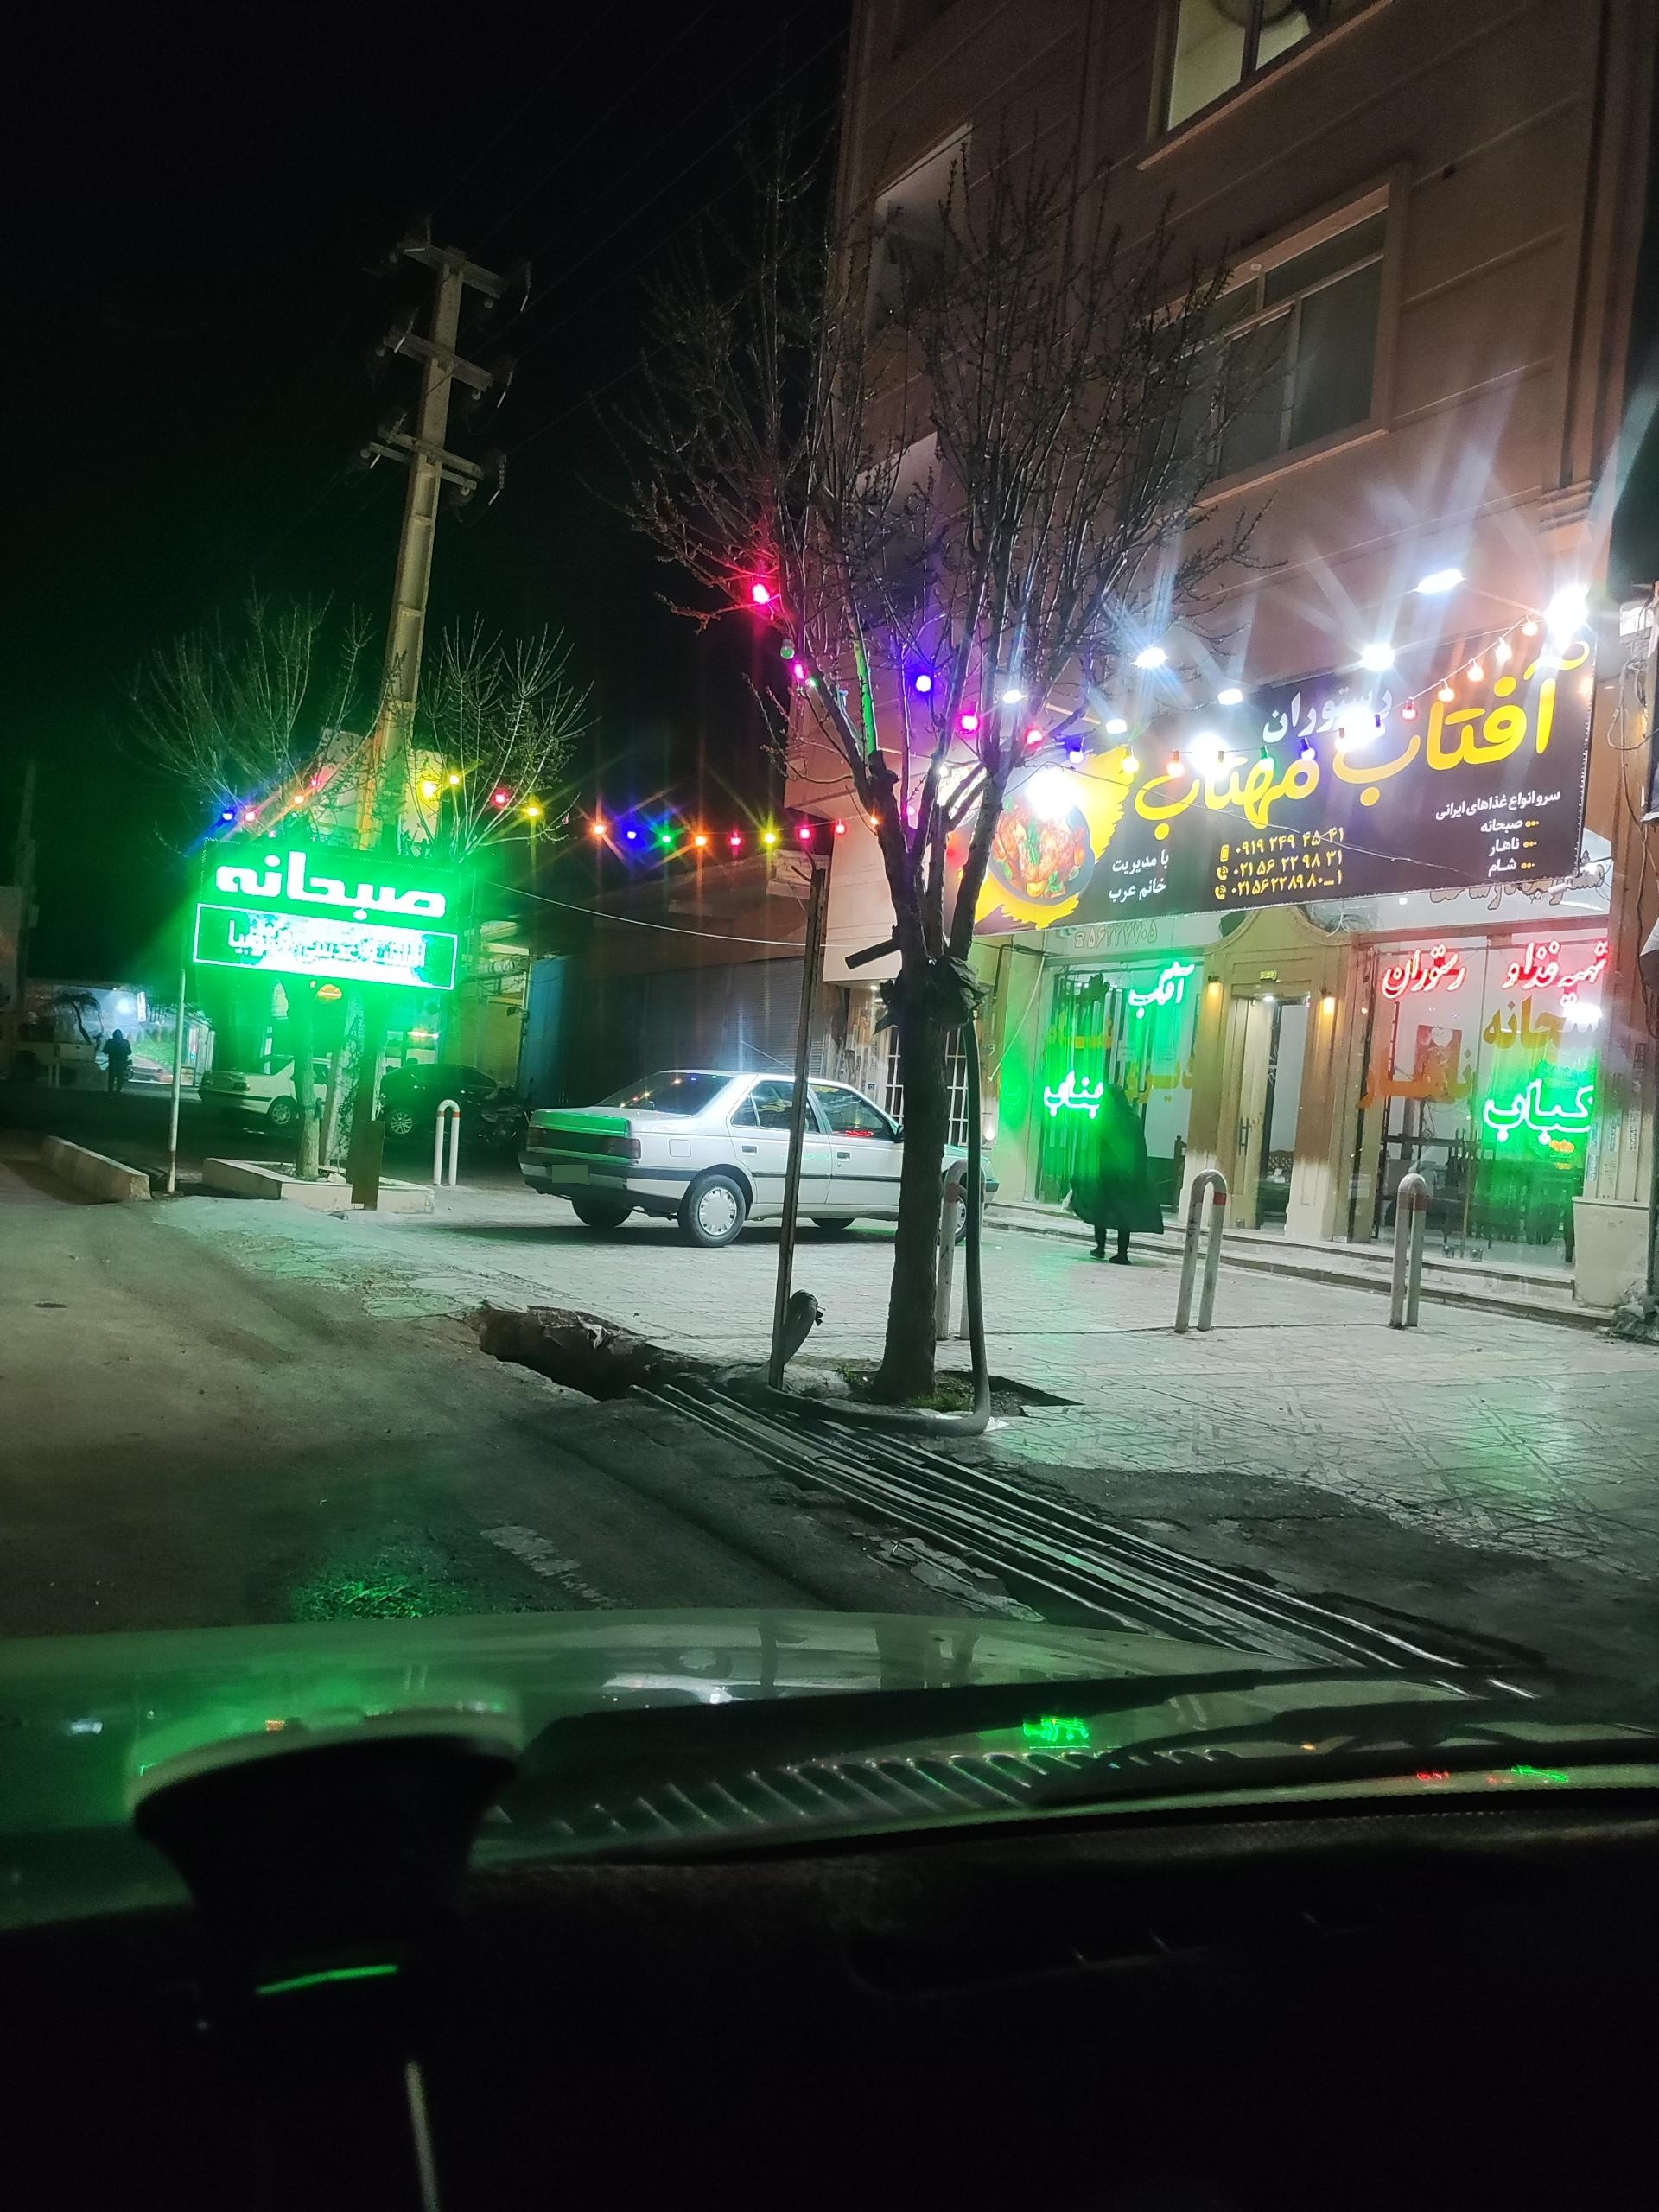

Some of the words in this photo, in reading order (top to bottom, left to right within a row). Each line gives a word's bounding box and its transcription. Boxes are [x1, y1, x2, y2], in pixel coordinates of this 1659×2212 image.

[1262, 687, 1392, 742] رستوران
[1332, 641, 1590, 806] آفتاب
[1135, 753, 1320, 841] مهتاب
[1466, 794, 1507, 816] غذاهای
[1508, 790, 1536, 810] انواع
[1537, 791, 1560, 806] سرو
[1436, 801, 1465, 820] ایرانی
[1480, 818, 1523, 833] صبحانه
[1488, 837, 1520, 856] ناهار
[1112, 857, 1157, 874] مدیریت
[1160, 849, 1169, 869] با
[1488, 858, 1516, 877] شام
[216, 850, 446, 921] صبحانه
[1109, 884, 1136, 903] عرب
[1139, 878, 1166, 900] خانم
[1382, 944, 1465, 999] رستوران
[1522, 940, 1560, 990] غذا
[1558, 941, 1608, 1007] تهیه
[1484, 1077, 1594, 1145] کباب
